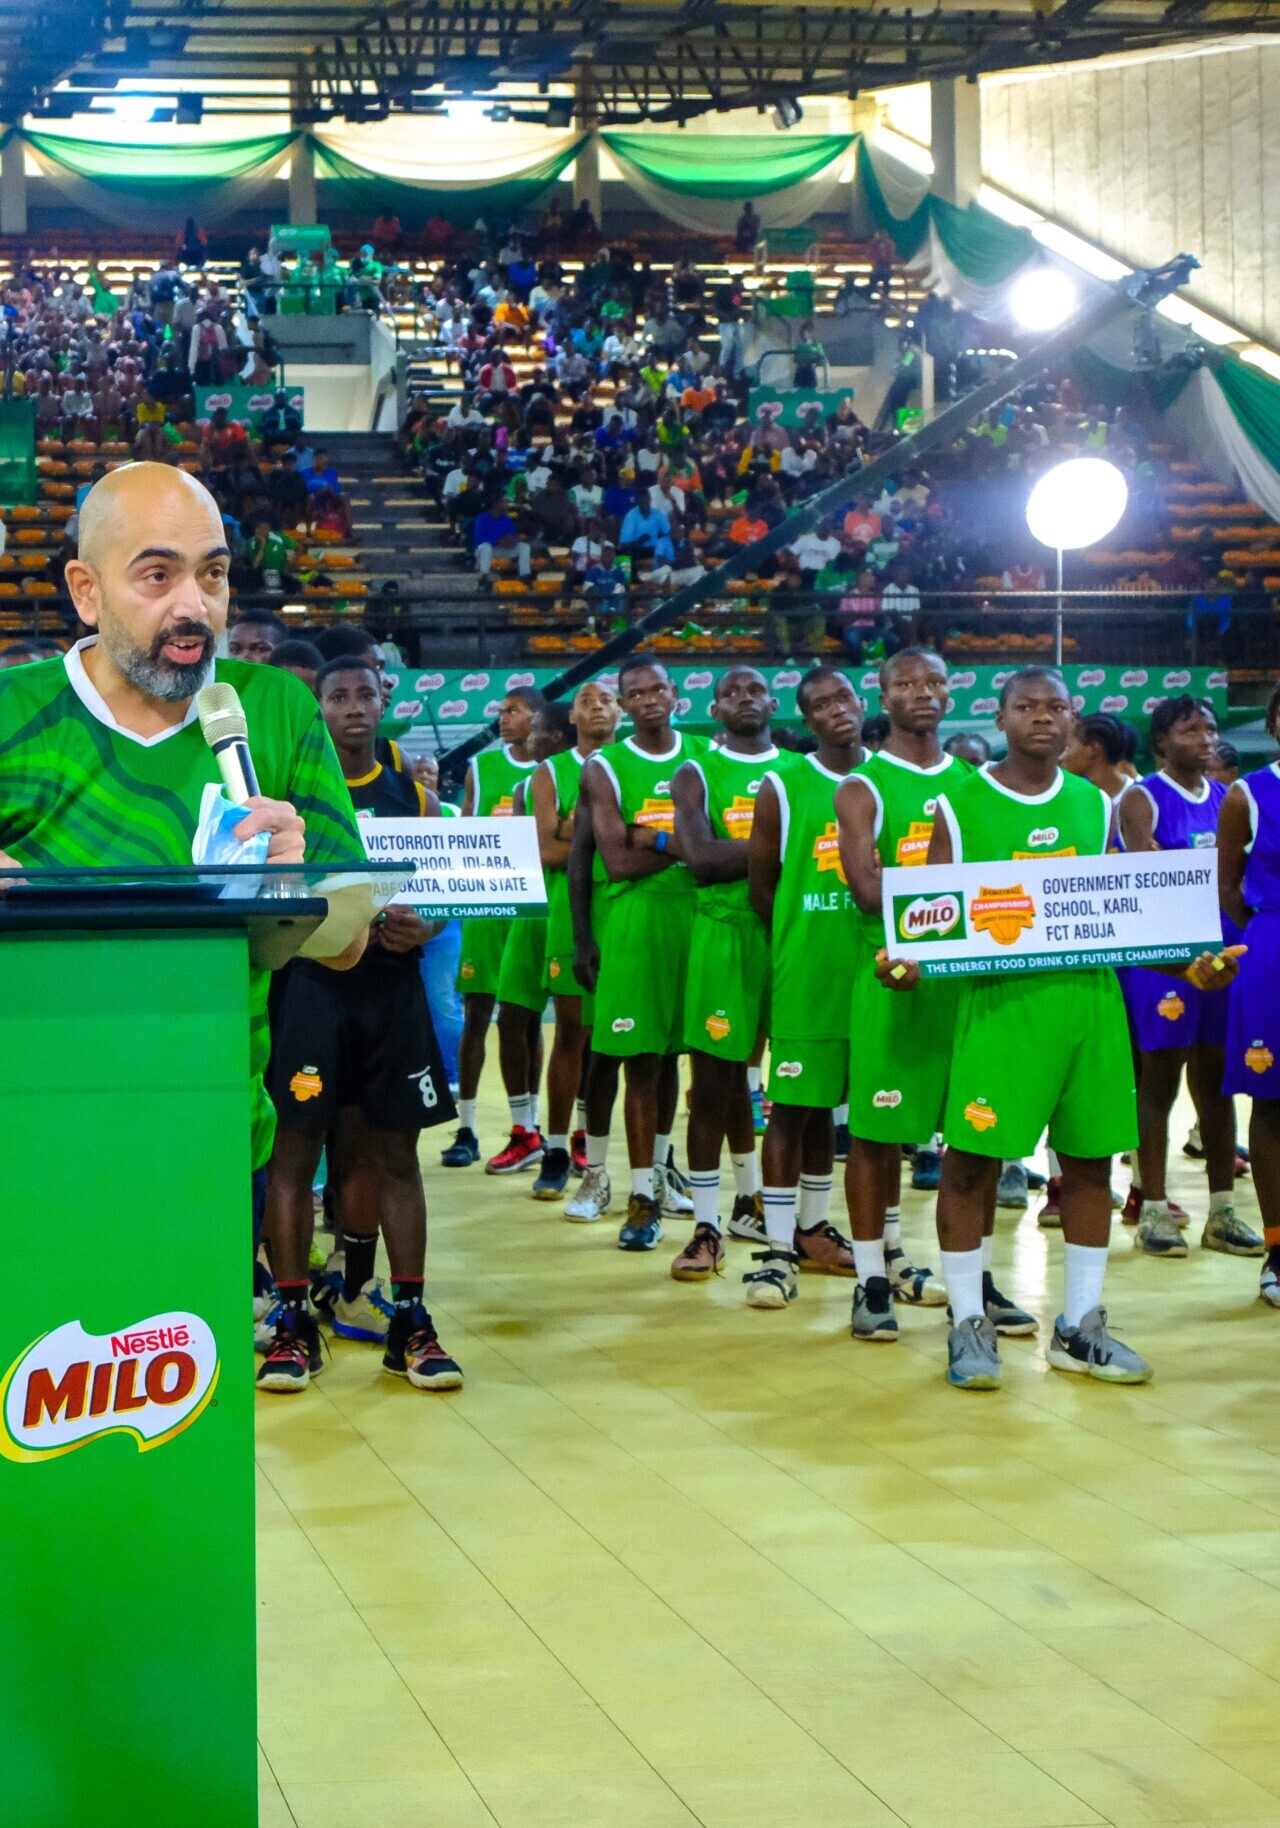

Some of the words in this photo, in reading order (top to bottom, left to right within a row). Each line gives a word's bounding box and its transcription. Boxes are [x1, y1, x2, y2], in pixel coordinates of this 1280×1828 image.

[441, 704, 465, 714] MILO
[366, 834, 444, 851] VICTORROTI
[449, 834, 502, 850] PRIVATE
[1032, 831, 1056, 843] MILO
[448, 878, 485, 892] OGUN
[490, 877, 528, 892] STATE
[1042, 874, 1131, 895] GOVERNMENT
[1135, 869, 1212, 888] SECONDARY
[453, 906, 517, 917] CHAMPIONS
[803, 892, 839, 911] MALE
[1044, 900, 1101, 918] SCHOOL,
[1104, 897, 1143, 915] KARU,
[908, 905, 954, 929] MILO
[1046, 925, 1070, 942] FCT
[1074, 922, 1116, 940] ABUJA
[927, 964, 948, 974] THE
[952, 961, 992, 972] ENERGY
[995, 958, 1026, 969] FOOD
[1028, 955, 1064, 968] DRINK
[1067, 954, 1080, 965] OF
[1082, 952, 1124, 964] FUTURE
[1126, 947, 1191, 961] CHAMPIONS
[419, 1074, 438, 1108] 8
[111, 1325, 189, 1357] Nestlé
[23, 1351, 198, 1429] MILO
